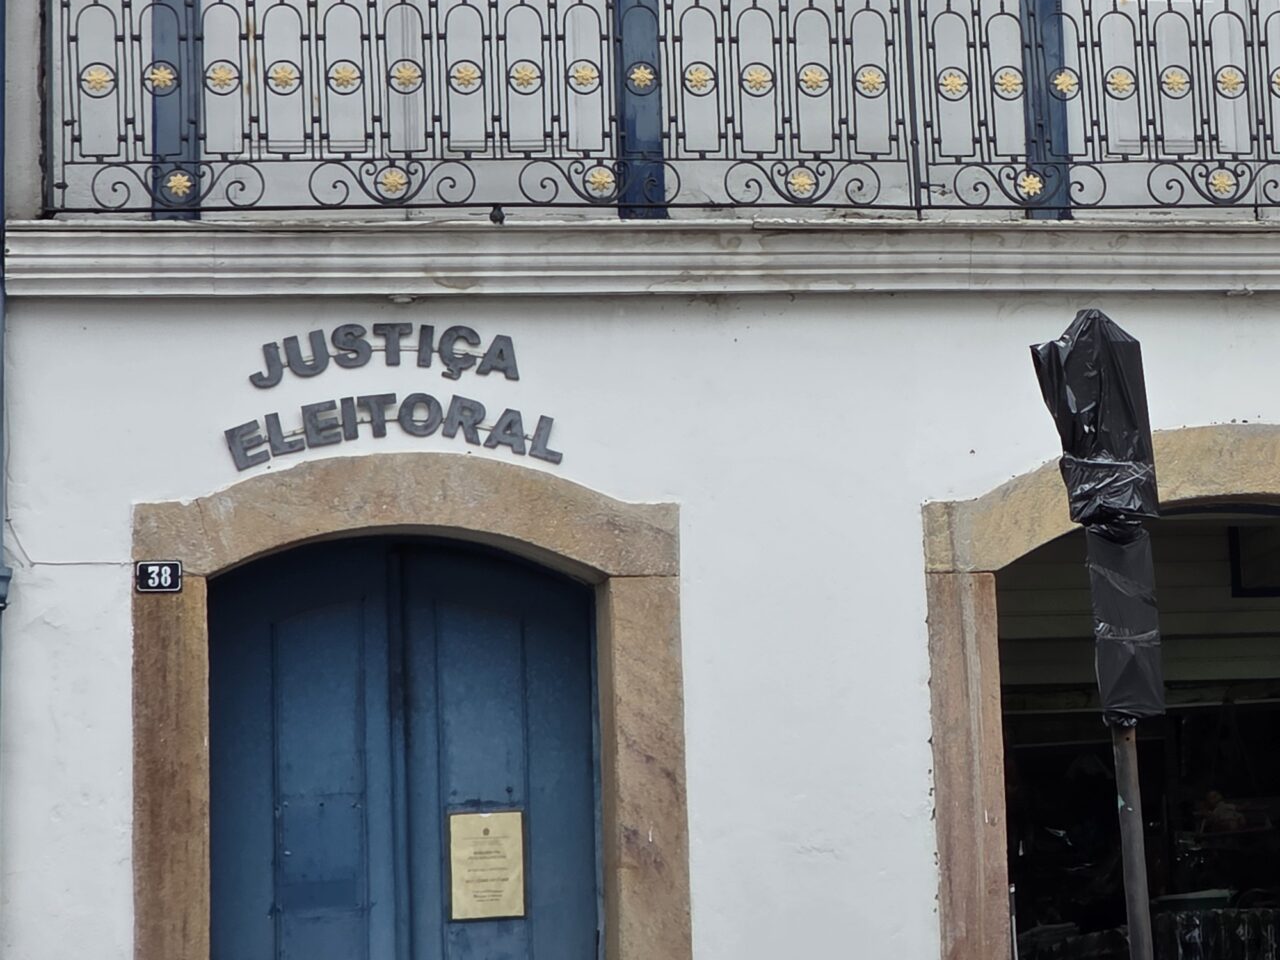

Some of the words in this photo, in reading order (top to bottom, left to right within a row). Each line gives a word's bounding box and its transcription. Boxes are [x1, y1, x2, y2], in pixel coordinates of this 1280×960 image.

[249, 322, 520, 389] JUSTIÇA
[224, 392, 563, 471] ELEITORAL
[147, 565, 171, 587] 38
